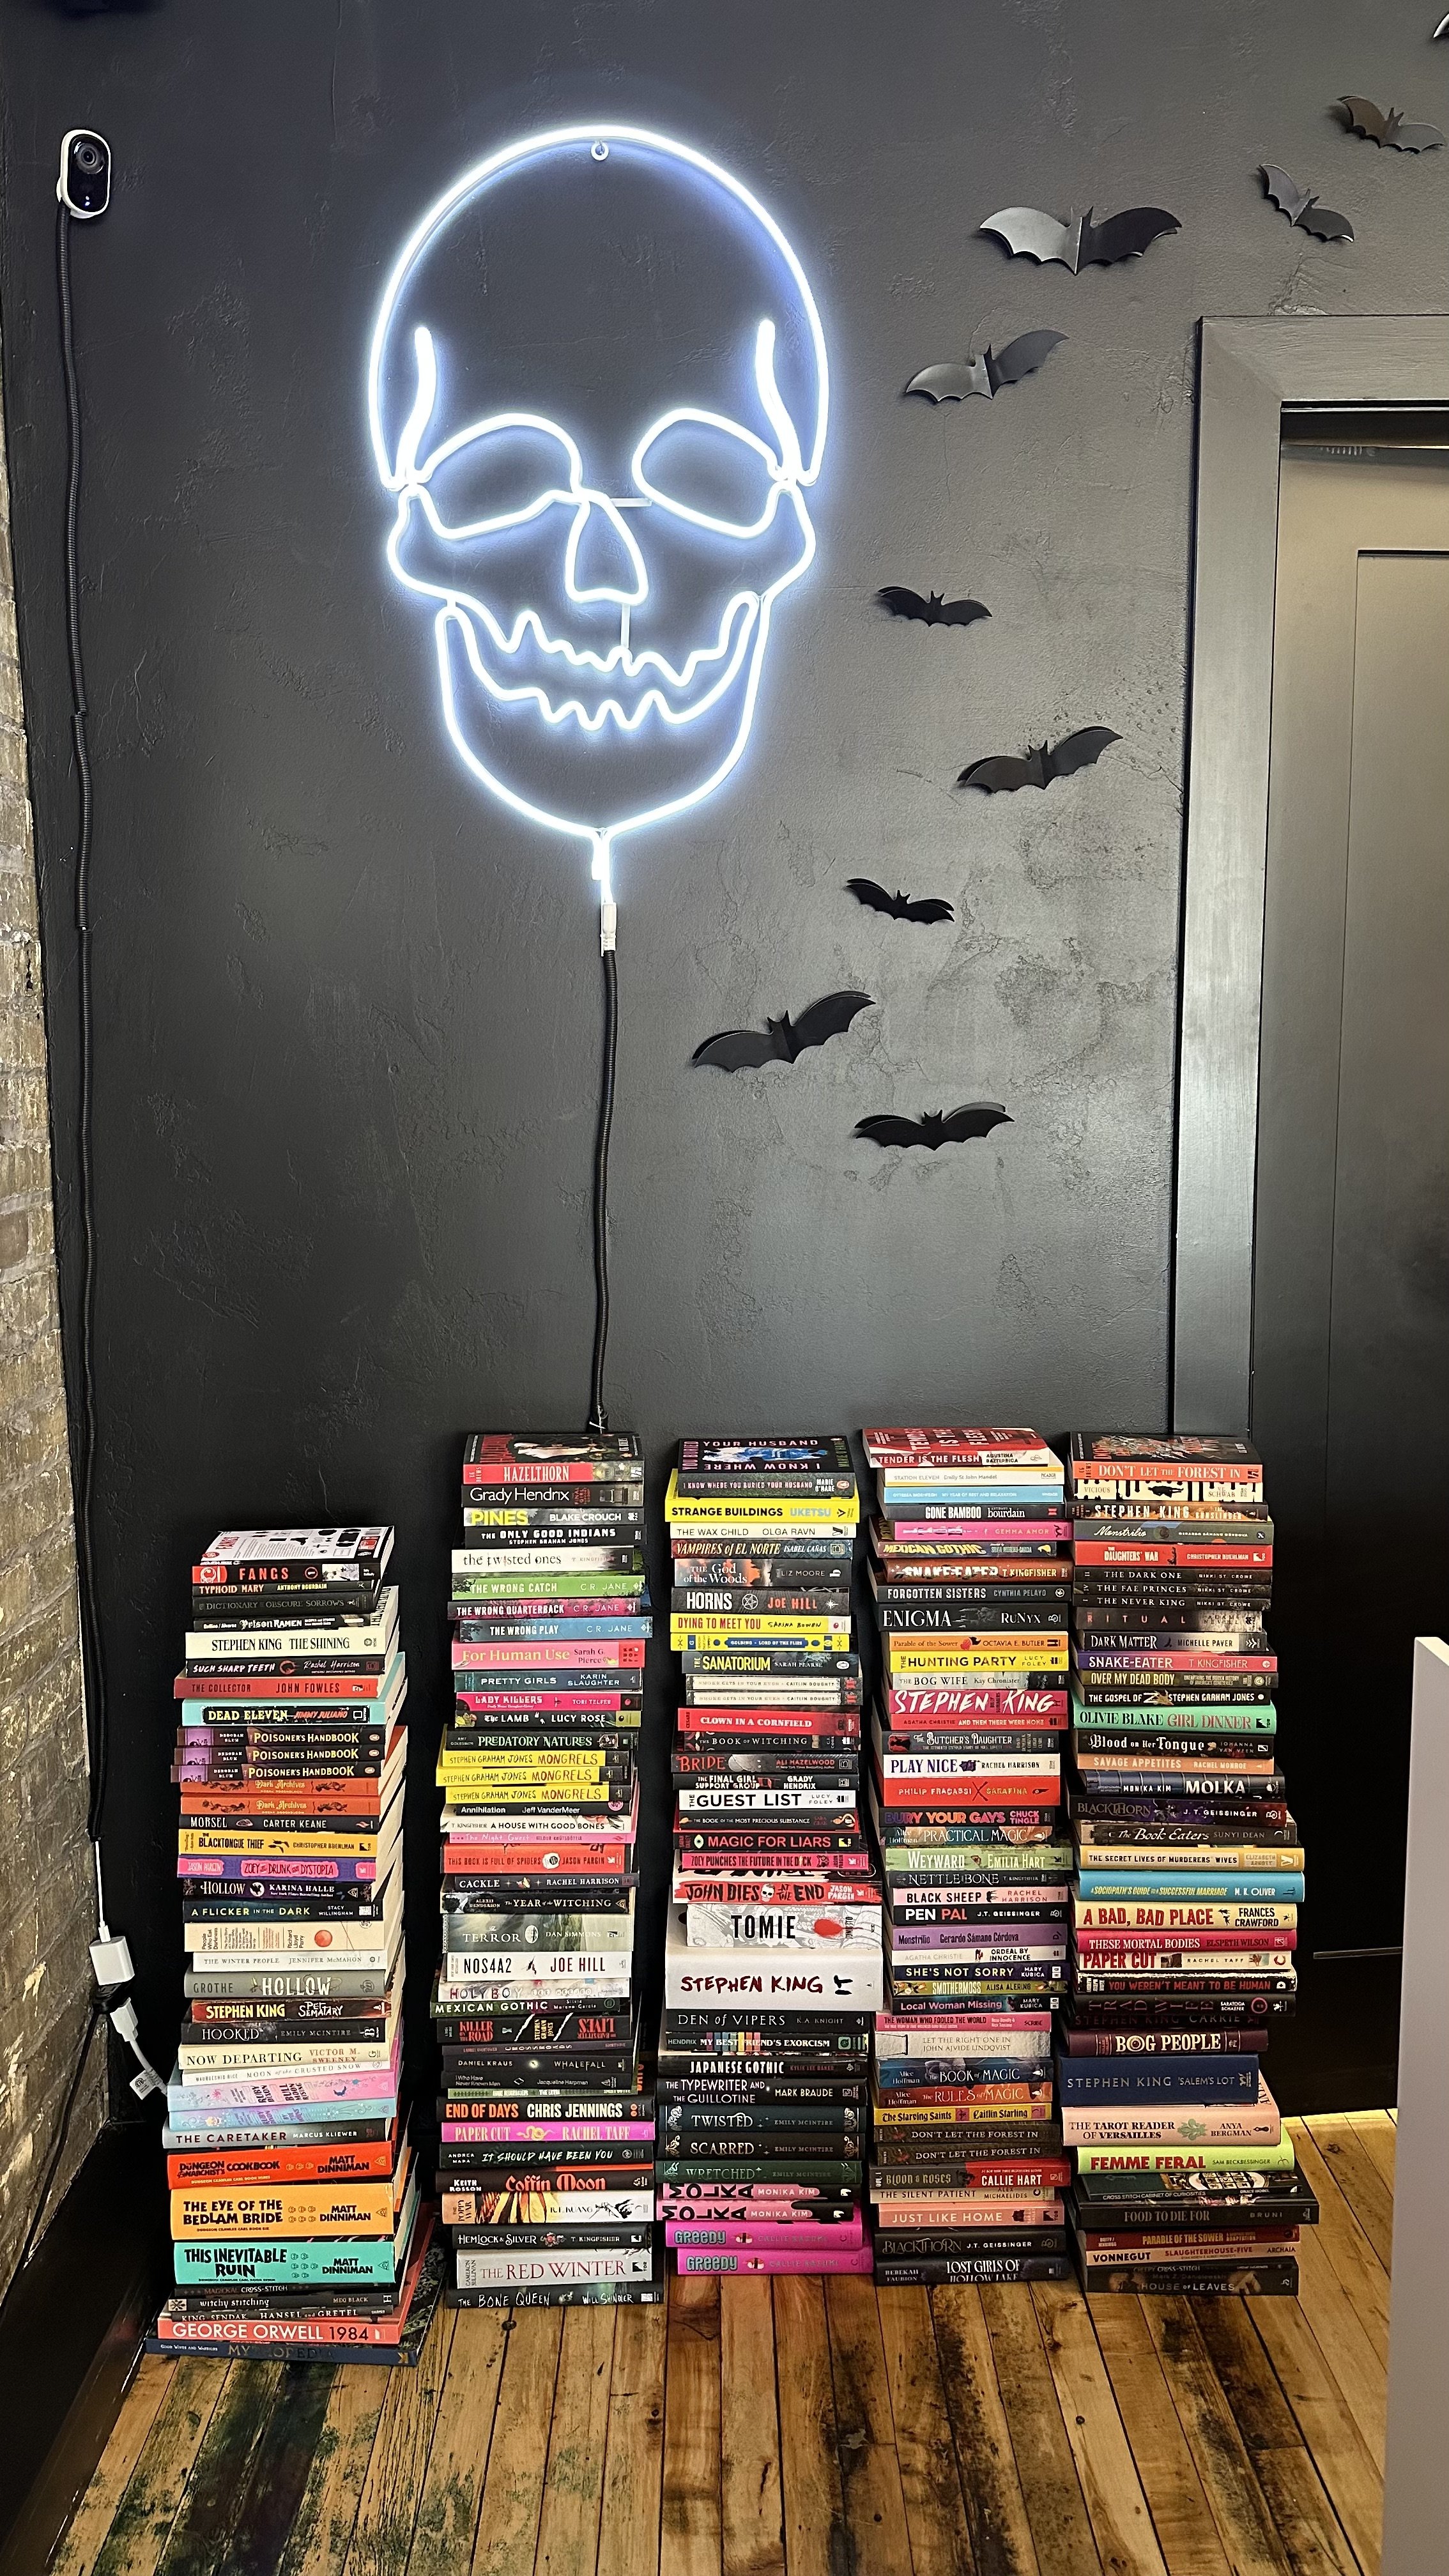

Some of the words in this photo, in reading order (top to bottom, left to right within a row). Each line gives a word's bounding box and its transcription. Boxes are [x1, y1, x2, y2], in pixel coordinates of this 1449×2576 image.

[504, 1466, 569, 1482] HAZELTHORN
[470, 1487, 512, 1504] Grady
[515, 1487, 569, 1501] Hendrix
[471, 1511, 528, 1525] PINES
[582, 1513, 621, 1521] CROUCH
[671, 1508, 722, 1516] STRANGE
[725, 1508, 783, 1516] BUILDINGS
[240, 1567, 289, 1580] FANGS
[887, 1590, 942, 1598] FORGOTTEN
[946, 1589, 986, 1598] SISTERS
[686, 1592, 732, 1609] HORNS
[767, 1598, 786, 1609] JOE
[792, 1598, 816, 1609] HILL
[678, 1618, 703, 1629] DYING
[707, 1618, 716, 1629] TO
[720, 1618, 742, 1629] MEET
[744, 1618, 760, 1629] YOU
[883, 1611, 951, 1627] ENIGMA
[211, 1639, 255, 1651] STEPHEN
[258, 1638, 282, 1650] KING
[289, 1637, 309, 1649] THE
[310, 1637, 349, 1648] SHINING
[703, 1656, 770, 1671] SANATORIUM
[908, 1658, 969, 1667] HUNTING
[973, 1657, 1016, 1666] PARTY
[1089, 1657, 1173, 1668] SNAKE-EATER
[192, 1684, 207, 1692] THE
[210, 1683, 251, 1692] COLLECTOR
[276, 1683, 300, 1693] JOHN
[305, 1682, 340, 1693] FOWLES
[894, 1690, 988, 1713] STEPHEN
[1002, 1689, 1055, 1713] KING
[208, 1710, 240, 1721] DEAD
[243, 1709, 288, 1720] ELEVEN
[551, 1714, 576, 1722] LUCY
[1080, 1712, 1119, 1724] OLIVIE
[1122, 1713, 1163, 1726] BLAKE
[254, 1731, 305, 1743] POISONER'S
[308, 1732, 359, 1742] HANDBOOK
[891, 1759, 923, 1773] PLAY
[927, 1759, 958, 1772] NICE
[1186, 1781, 1245, 1794] MOLKA
[696, 1795, 756, 1807] GUEST
[764, 1794, 801, 1806] LIST
[263, 1820, 296, 1828] CARTER
[300, 1820, 326, 1828] KEANE
[708, 1836, 755, 1847] MAGIC
[758, 1836, 785, 1847] FOR
[788, 1837, 831, 1847] LIARS
[907, 1892, 941, 1903] BLACK
[946, 1892, 981, 1903] SHEEP
[203, 1907, 250, 1916] FLICKER
[279, 1906, 310, 1915] DARK
[906, 1909, 936, 1920] PEN
[941, 1909, 967, 1920] PAL
[1084, 1908, 1092, 1925] A
[1098, 1908, 1130, 1926] BAD,
[1137, 1908, 1164, 1925] BAD
[1170, 1908, 1213, 1925] PLACE
[1239, 1908, 1275, 1917] FRANCES
[731, 1915, 796, 1938] TOMIE
[1235, 1918, 1278, 1927] CRAWFORD
[1089, 1939, 1121, 1949] THESE
[1123, 1939, 1162, 1949] MORTAL
[1165, 1938, 1200, 1948] BODIES
[464, 1958, 511, 1974] NOS4A2
[551, 1958, 572, 1972] JOE
[579, 1958, 605, 1972] HILL
[906, 1968, 940, 1977] SHE'S
[944, 1968, 969, 1977] NOT
[974, 1968, 1014, 1977] SORRY
[194, 1983, 233, 1993] GROTHE
[262, 1977, 332, 1996] HOLLOW
[681, 1975, 762, 1994] STEPHEN
[772, 1975, 823, 1994] KING
[833, 1975, 853, 1995] IT
[929, 2001, 965, 2009] Woman
[967, 2000, 1002, 2009] Missing
[206, 2005, 254, 2019] STEPHEN
[256, 2004, 285, 2017] KING
[678, 2015, 708, 2025] DEN
[715, 2015, 727, 2025] of
[733, 2015, 785, 2025] VIPERS
[1116, 2035, 1156, 2052] BOG
[1161, 2034, 1221, 2051] PEOPLE
[690, 2062, 742, 2073] JAPANESE
[745, 2062, 784, 2073] GOTHIC
[1068, 2078, 1130, 2087] STEPHEN
[1137, 2077, 1171, 2085] KING
[446, 2104, 469, 2118] END
[471, 2104, 486, 2117] OF
[489, 2104, 519, 2117] DAYS
[527, 2103, 562, 2118] CHRIS
[565, 2103, 622, 2117] JENNINGS
[1091, 2156, 1149, 2170] FEMME
[1156, 2156, 1206, 2169] FERAL
[505, 2176, 551, 2191] Coffin
[556, 2174, 606, 2190] Moon
[981, 2175, 1013, 2186] CALLIE
[1017, 2175, 1042, 2185] HART
[183, 2201, 209, 2212] THE
[211, 2201, 234, 2211] EYE
[238, 2201, 255, 2211] OF
[259, 2199, 282, 2211] THE
[183, 2213, 238, 2225] BEDLAM
[243, 2212, 283, 2223] BRIDE
[892, 2214, 923, 2223] JUST
[929, 2214, 957, 2222] LIKE
[1093, 2253, 1151, 2262] VONNEGUT
[480, 2267, 503, 2278] THE
[507, 2264, 544, 2280] RED
[548, 2260, 627, 2277] WINTER
[172, 2323, 247, 2338] GEORGE
[254, 2324, 323, 2339] ORWELL
[329, 2326, 369, 2340] 1984
